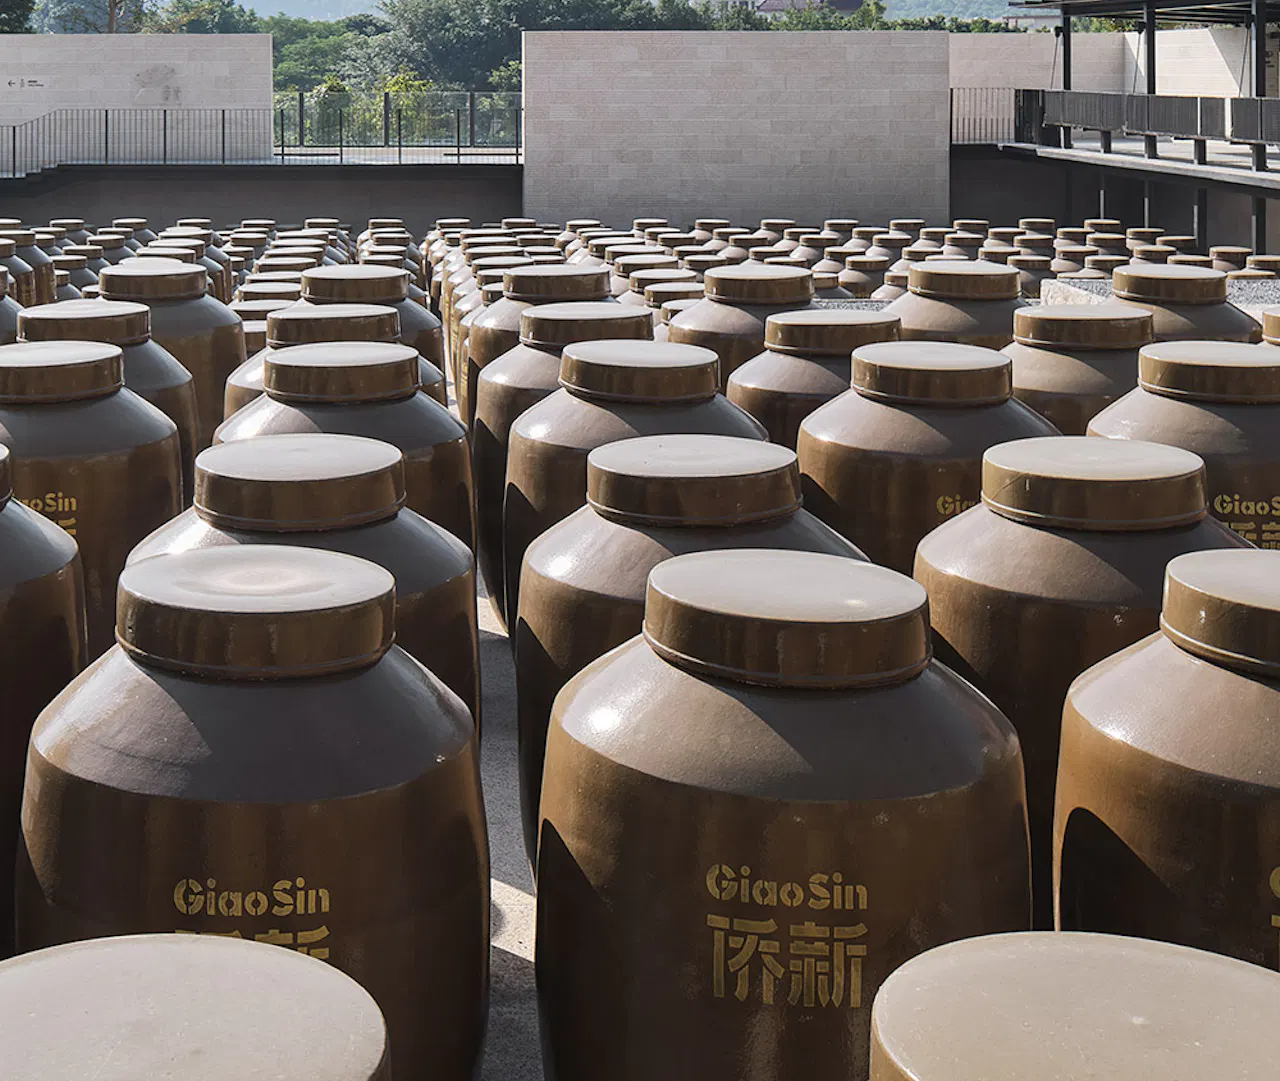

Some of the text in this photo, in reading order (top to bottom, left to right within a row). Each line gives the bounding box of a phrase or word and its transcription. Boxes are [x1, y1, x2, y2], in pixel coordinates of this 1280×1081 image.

[174, 877, 330, 917] GiaoSin
[706, 864, 868, 910] GiaoSin
[706, 914, 868, 1008] 侨新
